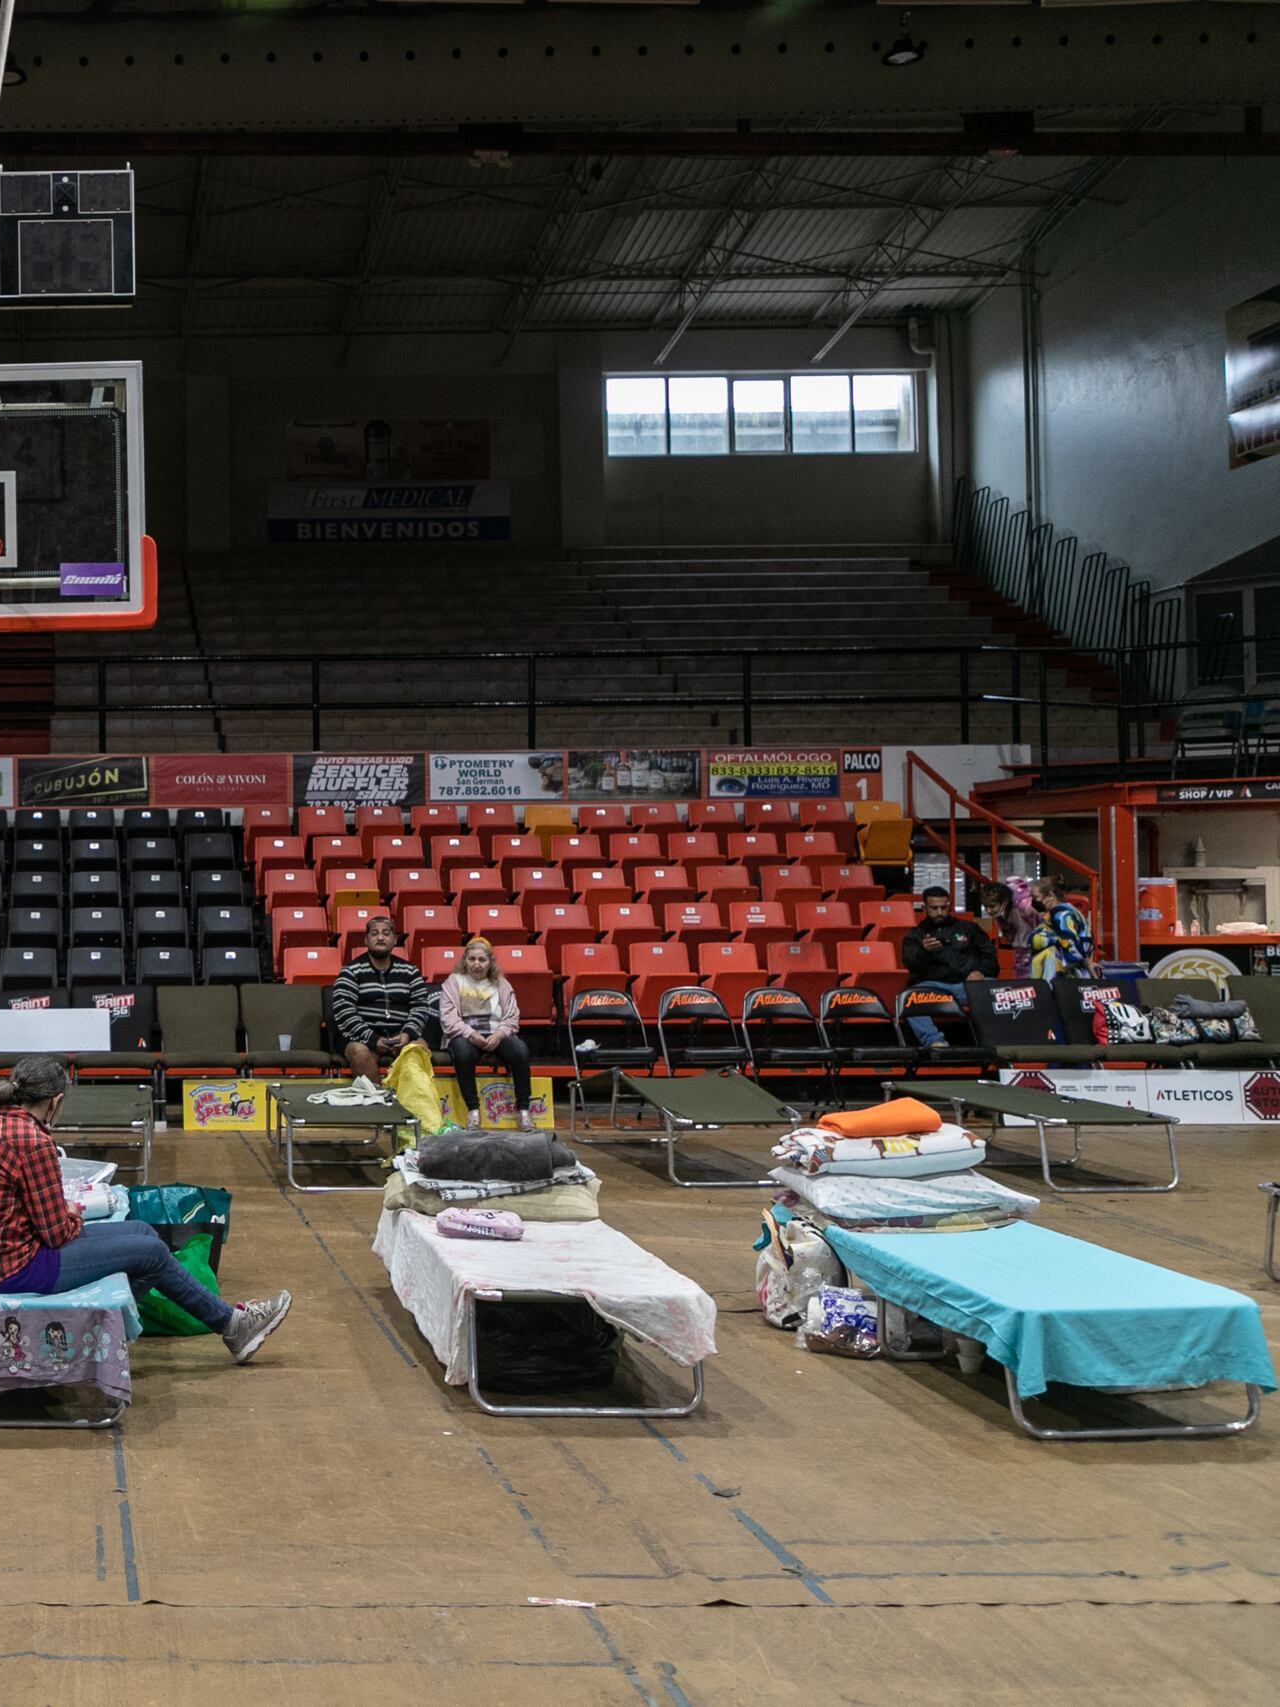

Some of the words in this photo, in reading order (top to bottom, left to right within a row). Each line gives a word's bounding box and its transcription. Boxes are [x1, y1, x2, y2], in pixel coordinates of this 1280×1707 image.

[310, 488, 355, 508] First
[364, 488, 469, 507] MEDICAL
[296, 521, 480, 540] BIENVENIDOS
[347, 756, 383, 764] PIEZAS
[385, 756, 414, 764] LUGO
[714, 751, 832, 763] OFTALMÓLOGO
[844, 753, 880, 770] PALCO
[175, 773, 215, 784] COLÓN
[216, 775, 226, 784] &
[227, 774, 267, 784] VIVONI
[458, 769, 502, 778] WORLD
[34, 768, 119, 794] CUBUJÓN
[306, 777, 409, 791] MUFFLER
[456, 777, 471, 785] San
[811, 782, 831, 790] MD
[438, 786, 521, 796] 787.892.6016
[856, 778, 868, 800] 1
[1179, 790, 1207, 799] SHOP
[1209, 790, 1214, 798] /
[1216, 789, 1234, 798] VIP
[1157, 1090, 1233, 1101] ATLETICOS
[1254, 1087, 1280, 1096] AUT
